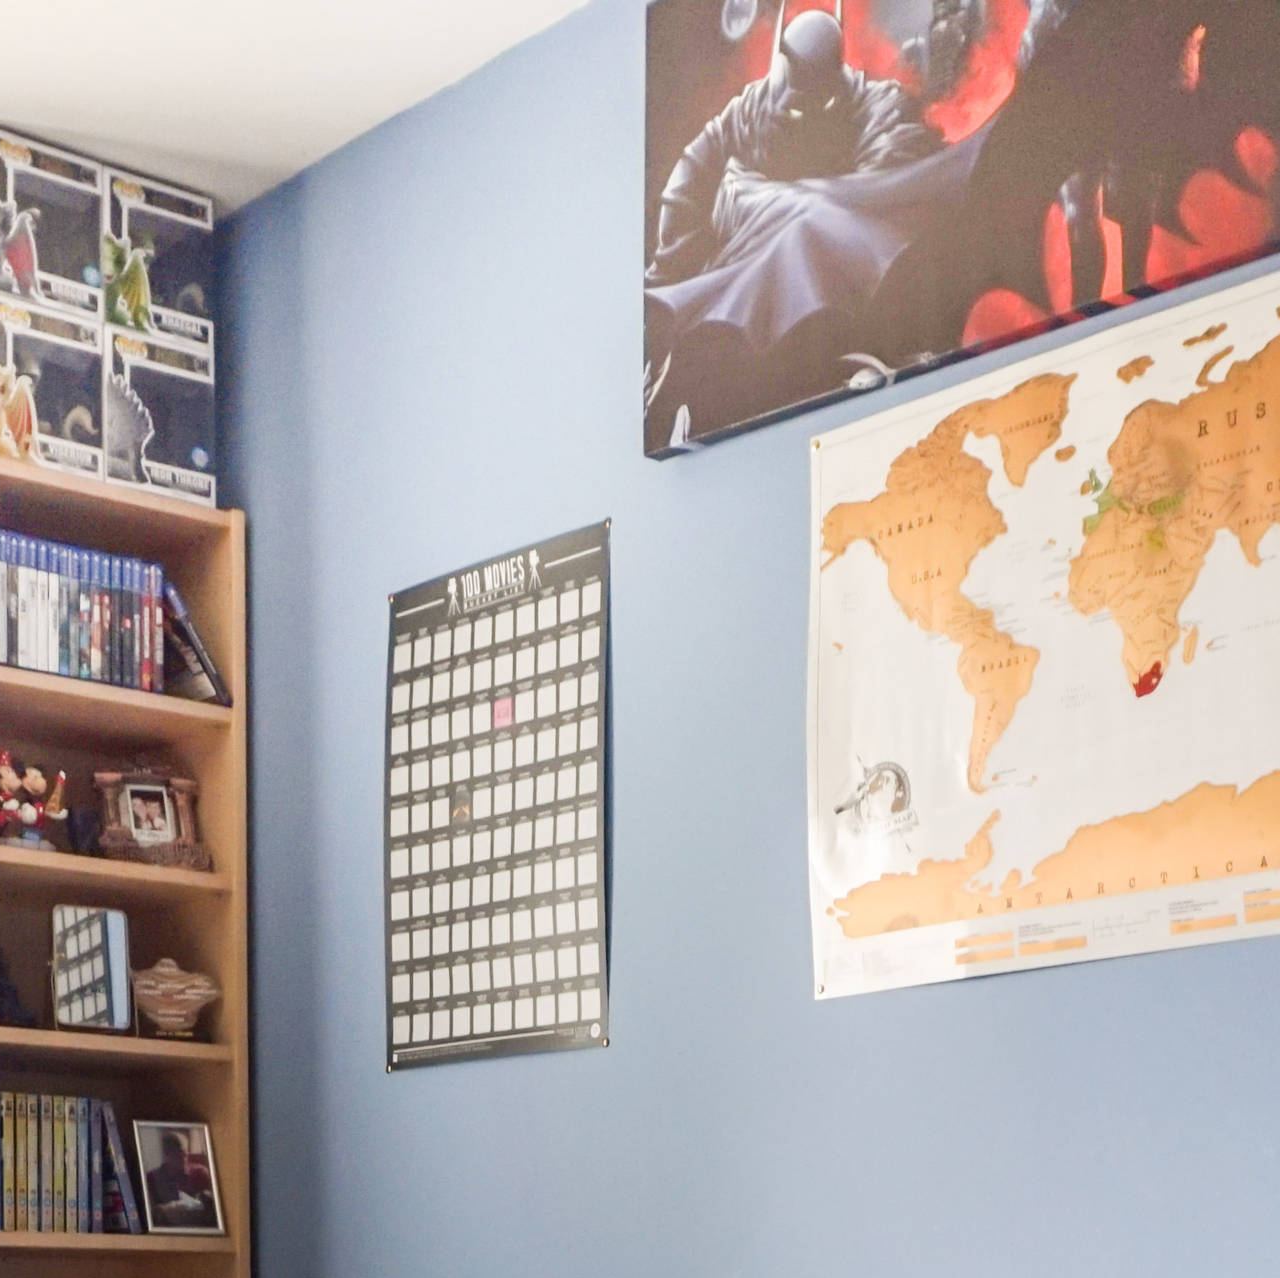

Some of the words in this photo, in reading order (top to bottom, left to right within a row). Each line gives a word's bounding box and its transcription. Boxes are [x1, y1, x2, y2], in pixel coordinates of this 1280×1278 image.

[877, 512, 934, 540] CANADA
[461, 569, 480, 599] 100
[484, 554, 525, 591] MOVIES
[976, 855, 1269, 915] ANTARCTICA
